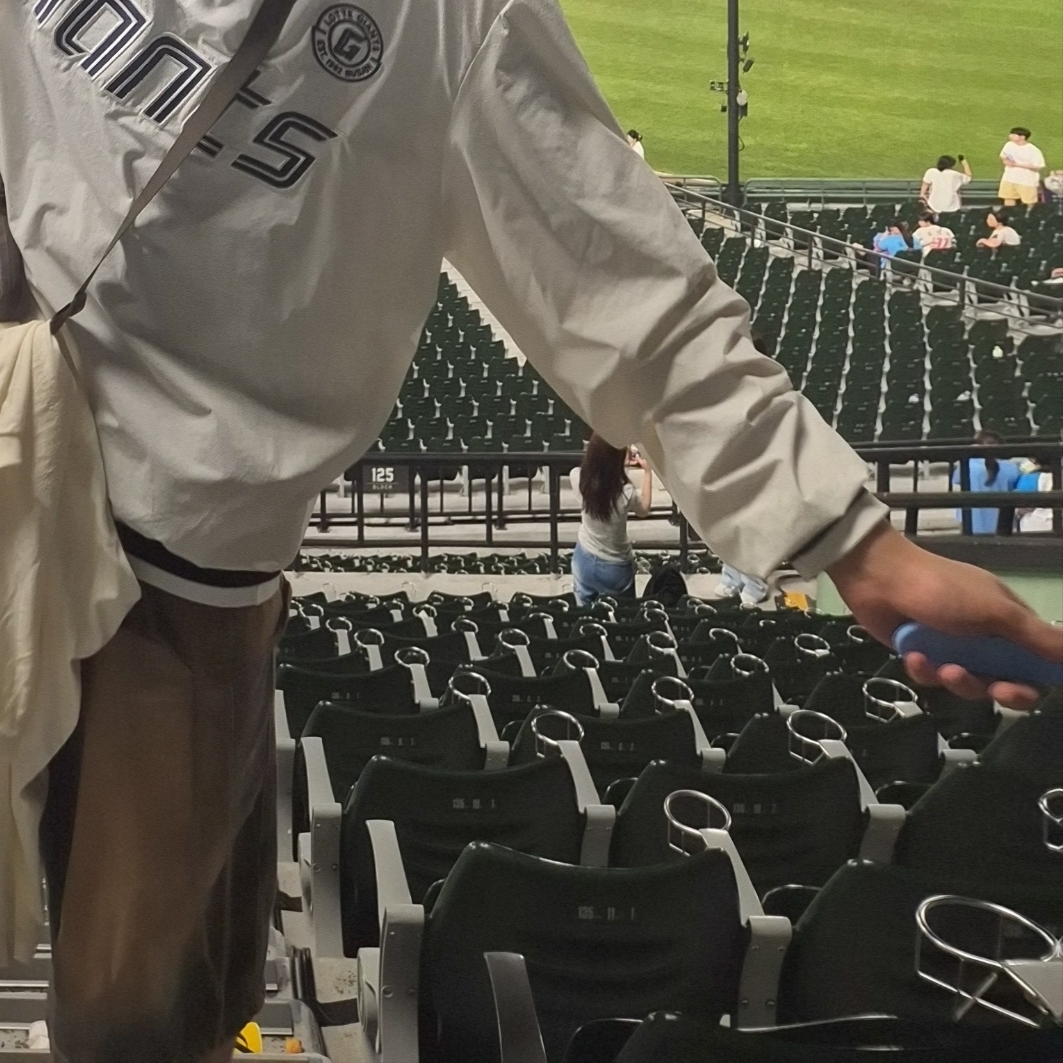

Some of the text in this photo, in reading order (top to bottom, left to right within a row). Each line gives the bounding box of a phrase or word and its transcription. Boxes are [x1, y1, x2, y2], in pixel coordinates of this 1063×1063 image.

[324, 9, 381, 52] LOTTE GIANTS
[372, 467, 394, 483] 125
